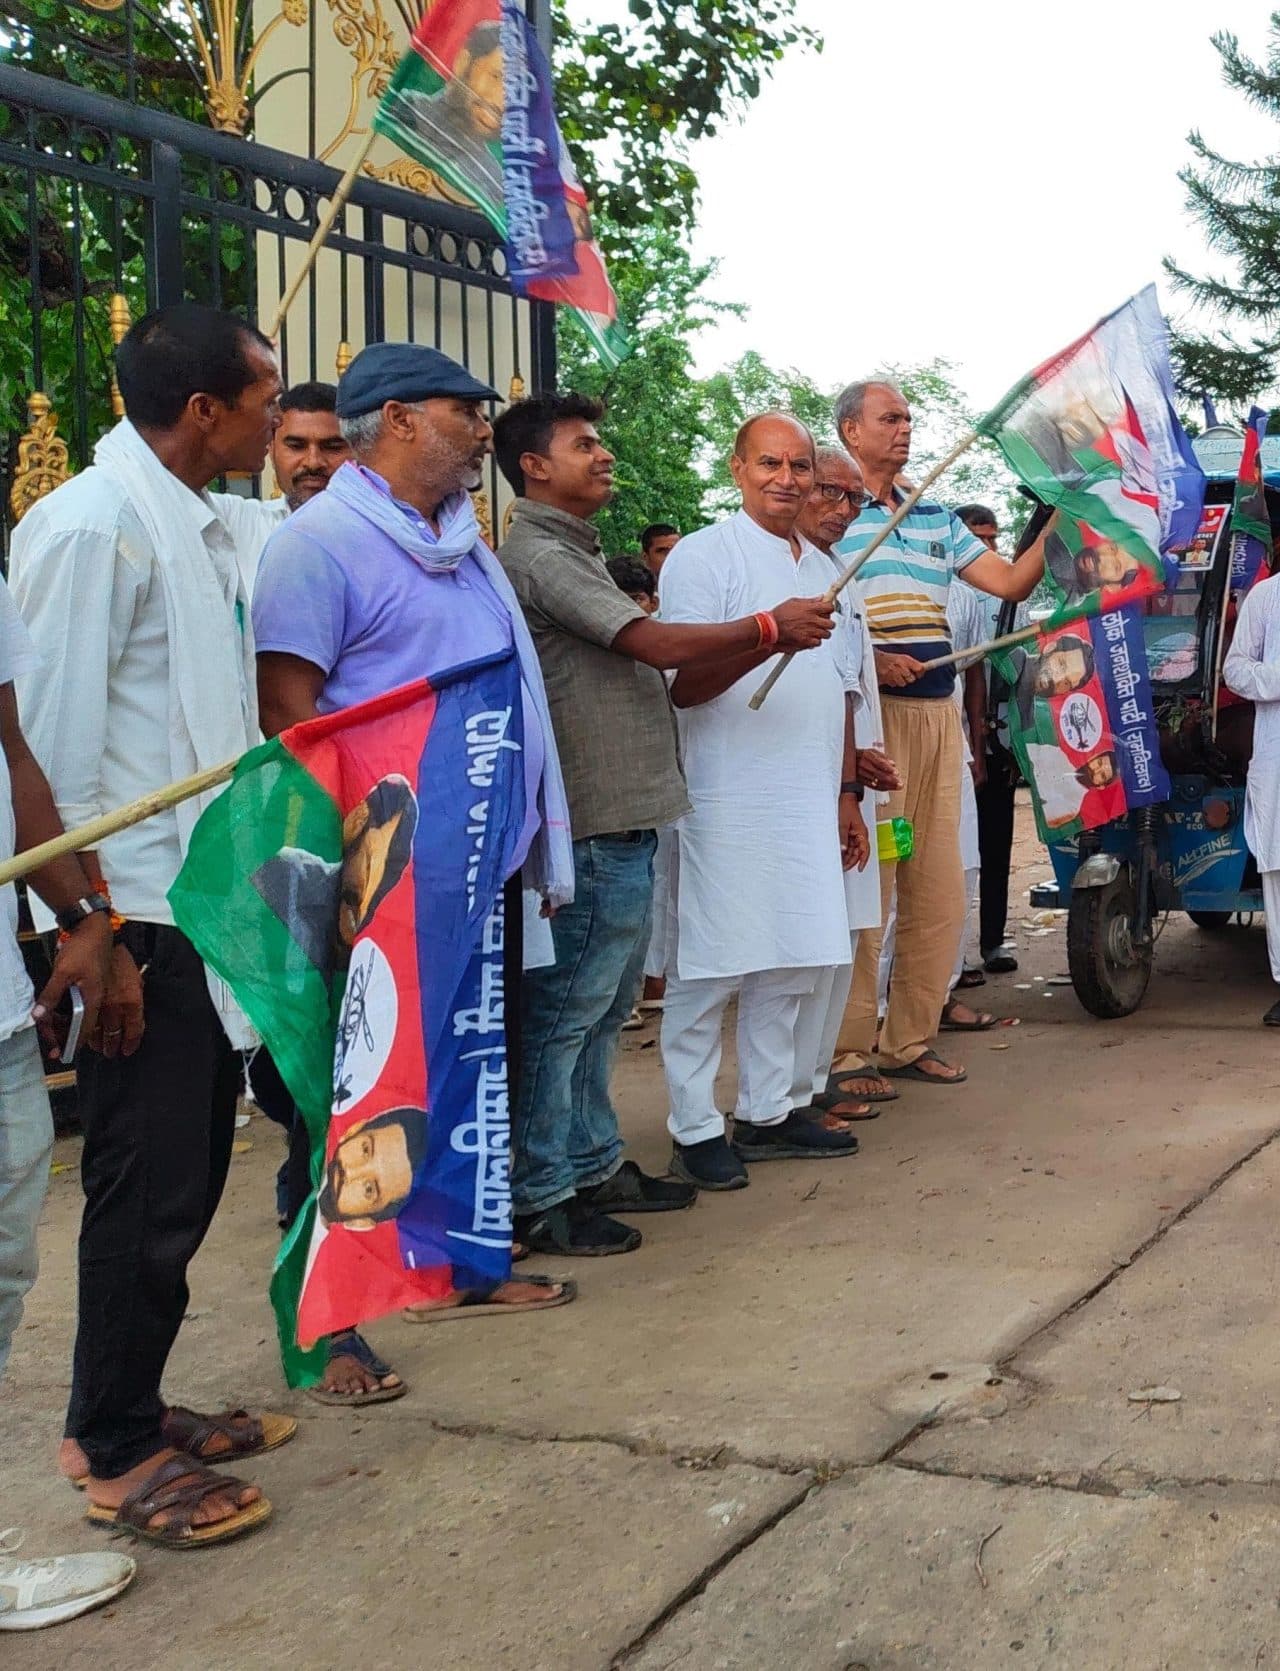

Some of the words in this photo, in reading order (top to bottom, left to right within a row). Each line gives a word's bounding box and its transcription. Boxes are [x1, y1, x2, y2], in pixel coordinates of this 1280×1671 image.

[1101, 610, 1130, 642] लोक
[1109, 641, 1141, 699] जनशक्ति
[1120, 698, 1147, 724] पार्टी
[1119, 725, 1156, 794] (रामविलास)
